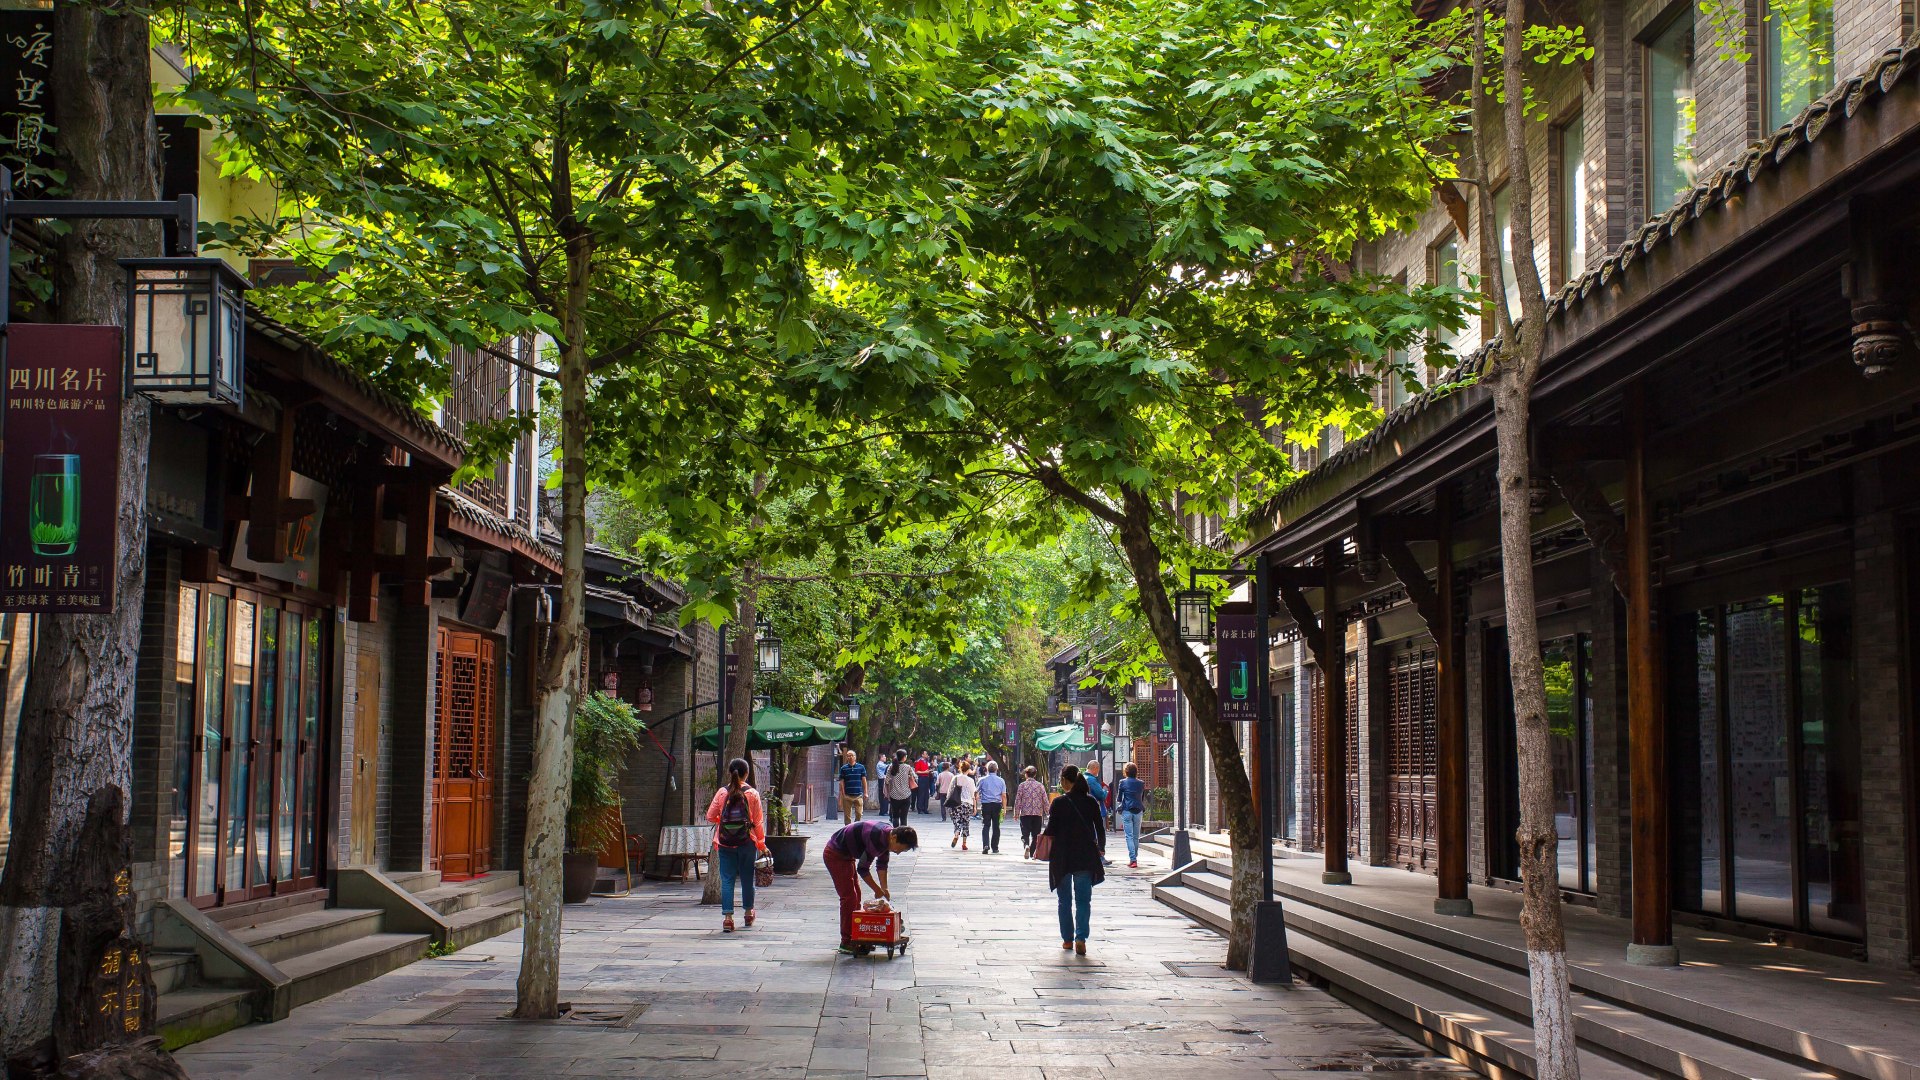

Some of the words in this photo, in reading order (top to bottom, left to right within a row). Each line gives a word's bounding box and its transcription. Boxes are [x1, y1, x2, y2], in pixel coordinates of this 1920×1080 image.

[9, 367, 107, 391] 四川名片
[10, 398, 106, 410] 四川特色旅游产品
[7, 564, 81, 588] 竹叶青
[4, 594, 50, 607] 至美绿茶
[56, 594, 101, 606] 至美味道
[1221, 629, 1256, 639] 春茶上市
[1223, 701, 1250, 711] 竹叶青
